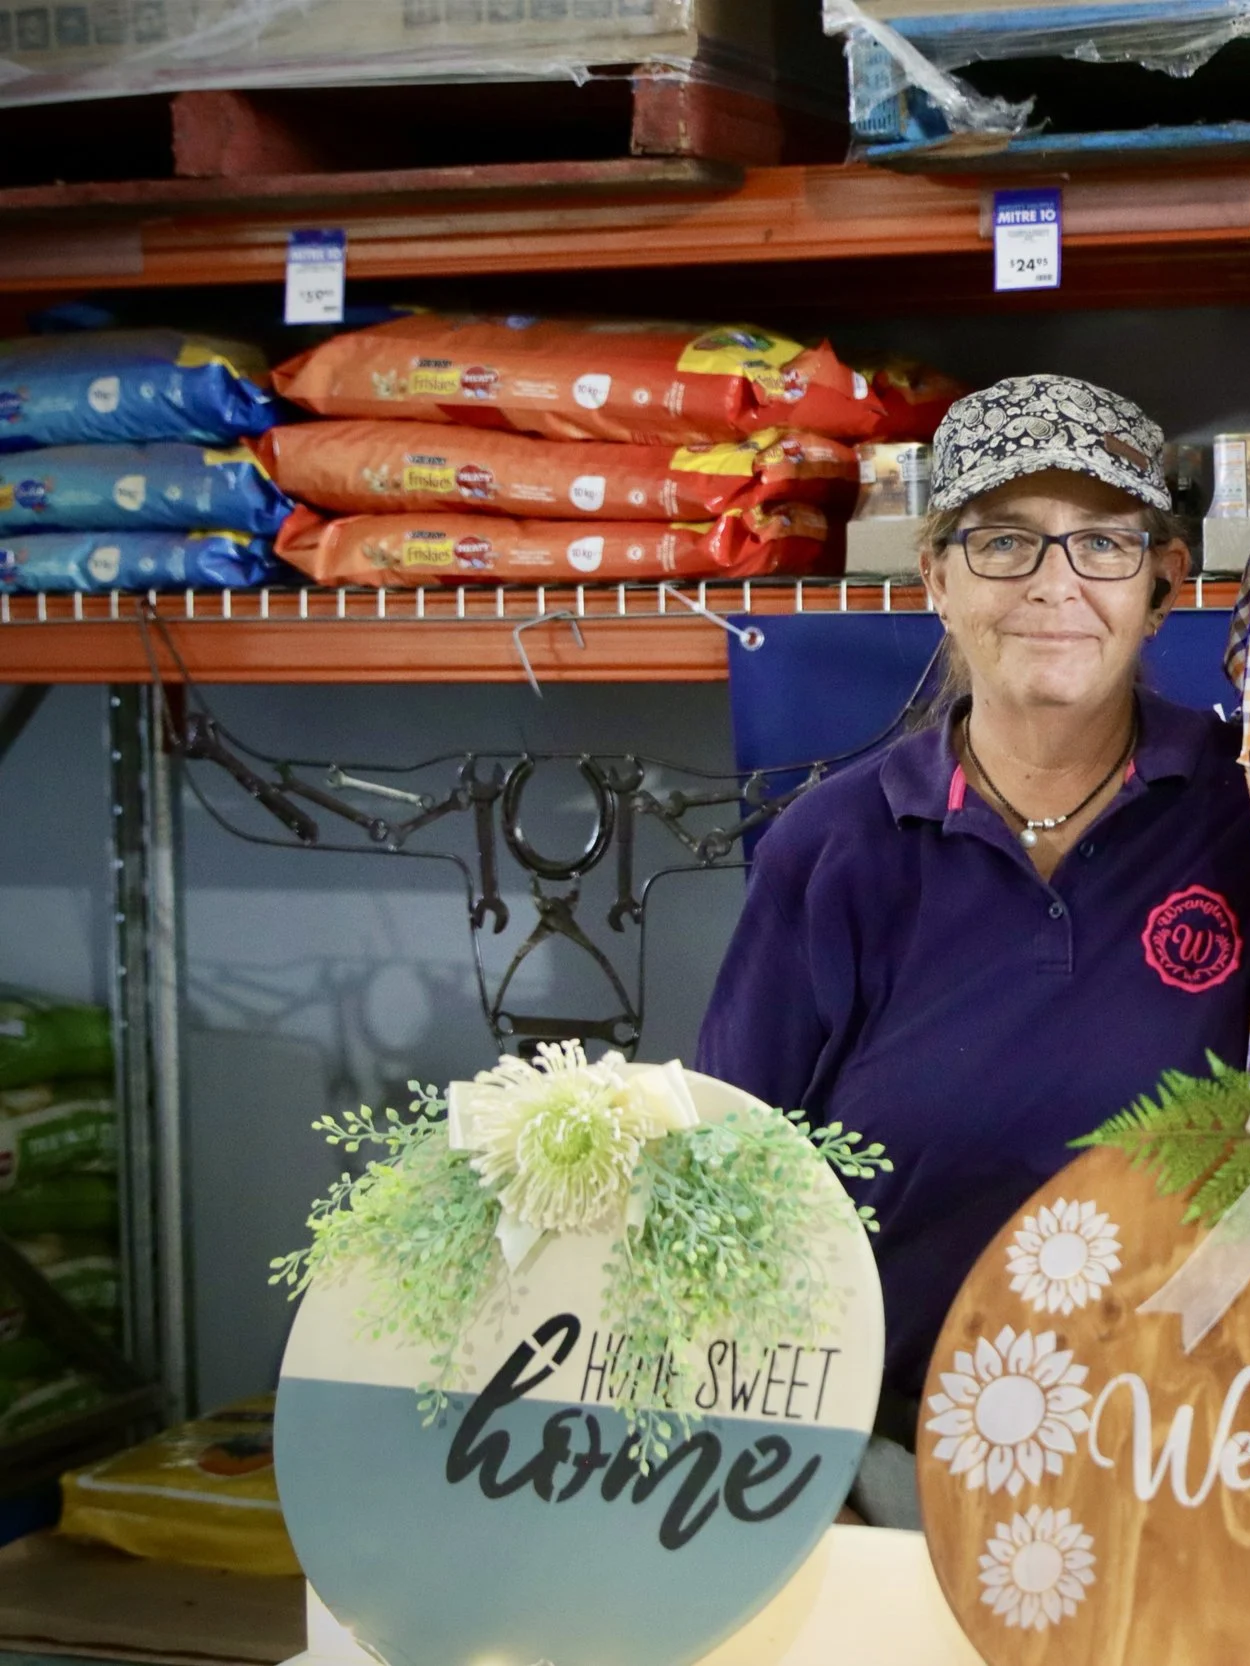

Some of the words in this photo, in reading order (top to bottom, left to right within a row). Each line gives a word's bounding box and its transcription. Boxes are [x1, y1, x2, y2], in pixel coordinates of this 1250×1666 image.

[998, 210, 1037, 223] MITRE
[1040, 209, 1056, 221] 10
[413, 374, 457, 392] Friskies
[408, 470, 453, 489] Friskies
[408, 545, 452, 563] Friskies
[695, 1339, 842, 1420] SWEET
[446, 1313, 822, 1551] home
